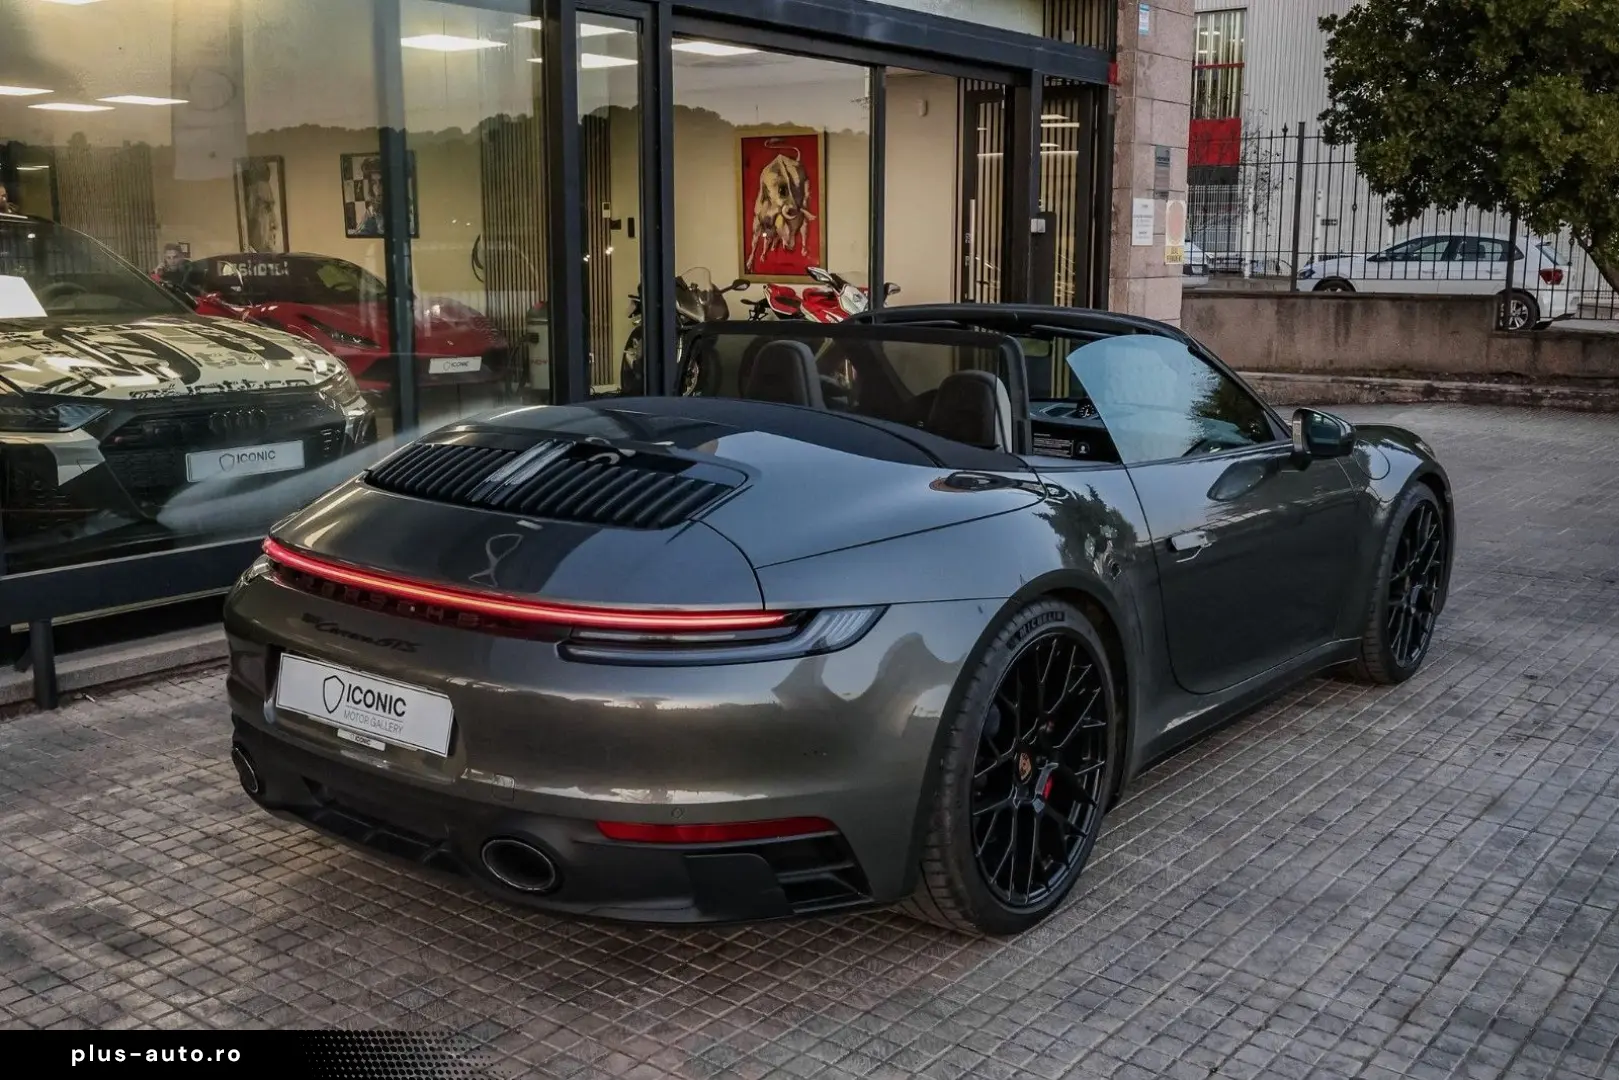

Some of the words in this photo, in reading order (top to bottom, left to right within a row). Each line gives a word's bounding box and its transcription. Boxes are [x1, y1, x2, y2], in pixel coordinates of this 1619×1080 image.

[236, 449, 276, 464] ICONIC
[346, 683, 407, 718] ICONIC
[343, 709, 370, 725] MOTOR
[370, 716, 404, 735] GALLERY
